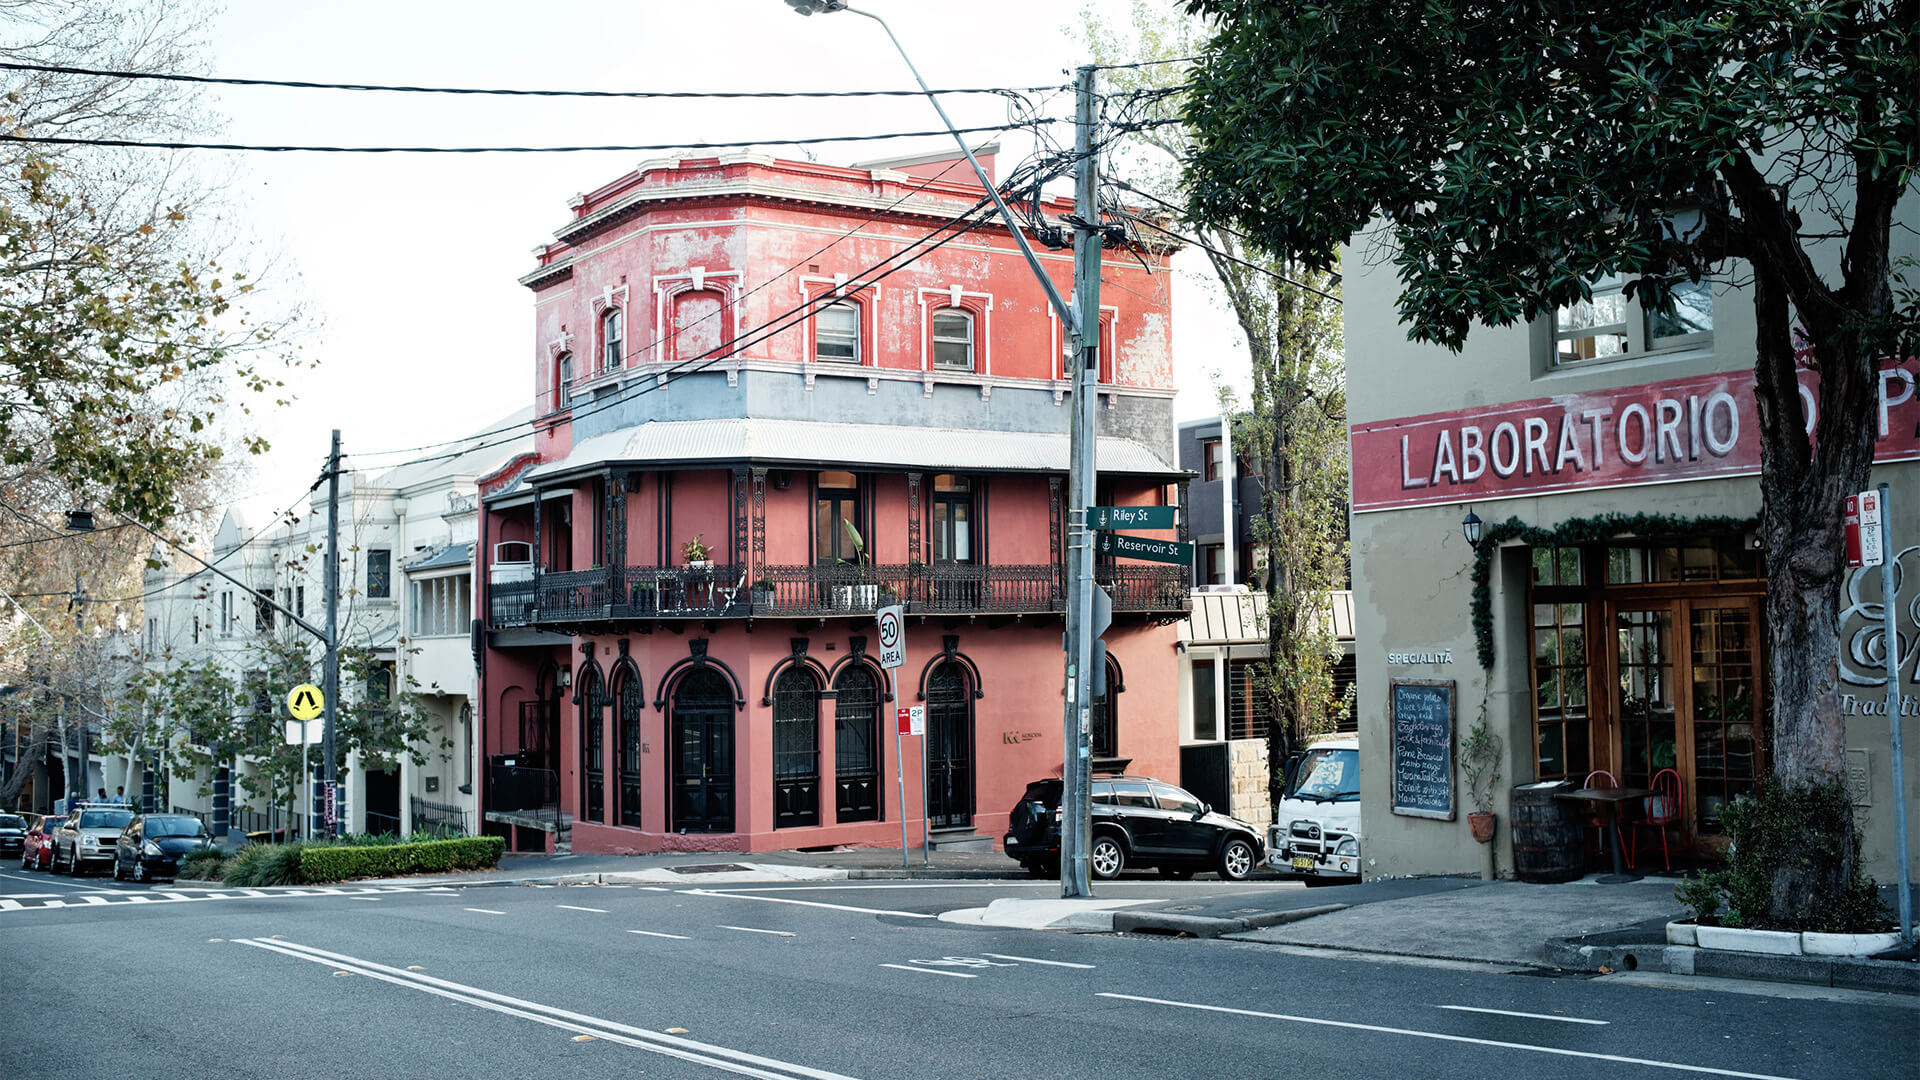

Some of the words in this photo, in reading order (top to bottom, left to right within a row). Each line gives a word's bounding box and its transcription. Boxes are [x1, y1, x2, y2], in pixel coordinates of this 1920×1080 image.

[1402, 392, 1740, 488] LABORATORIO
[1113, 509, 1136, 524] Riley
[1138, 509, 1148, 520] St
[1117, 537, 1166, 553] Reservoir
[1168, 544, 1178, 555] St
[881, 621, 896, 640] 50
[881, 650, 900, 664] AREA
[911, 709, 923, 717] 2P
[1841, 693, 1920, 717] Tradti
